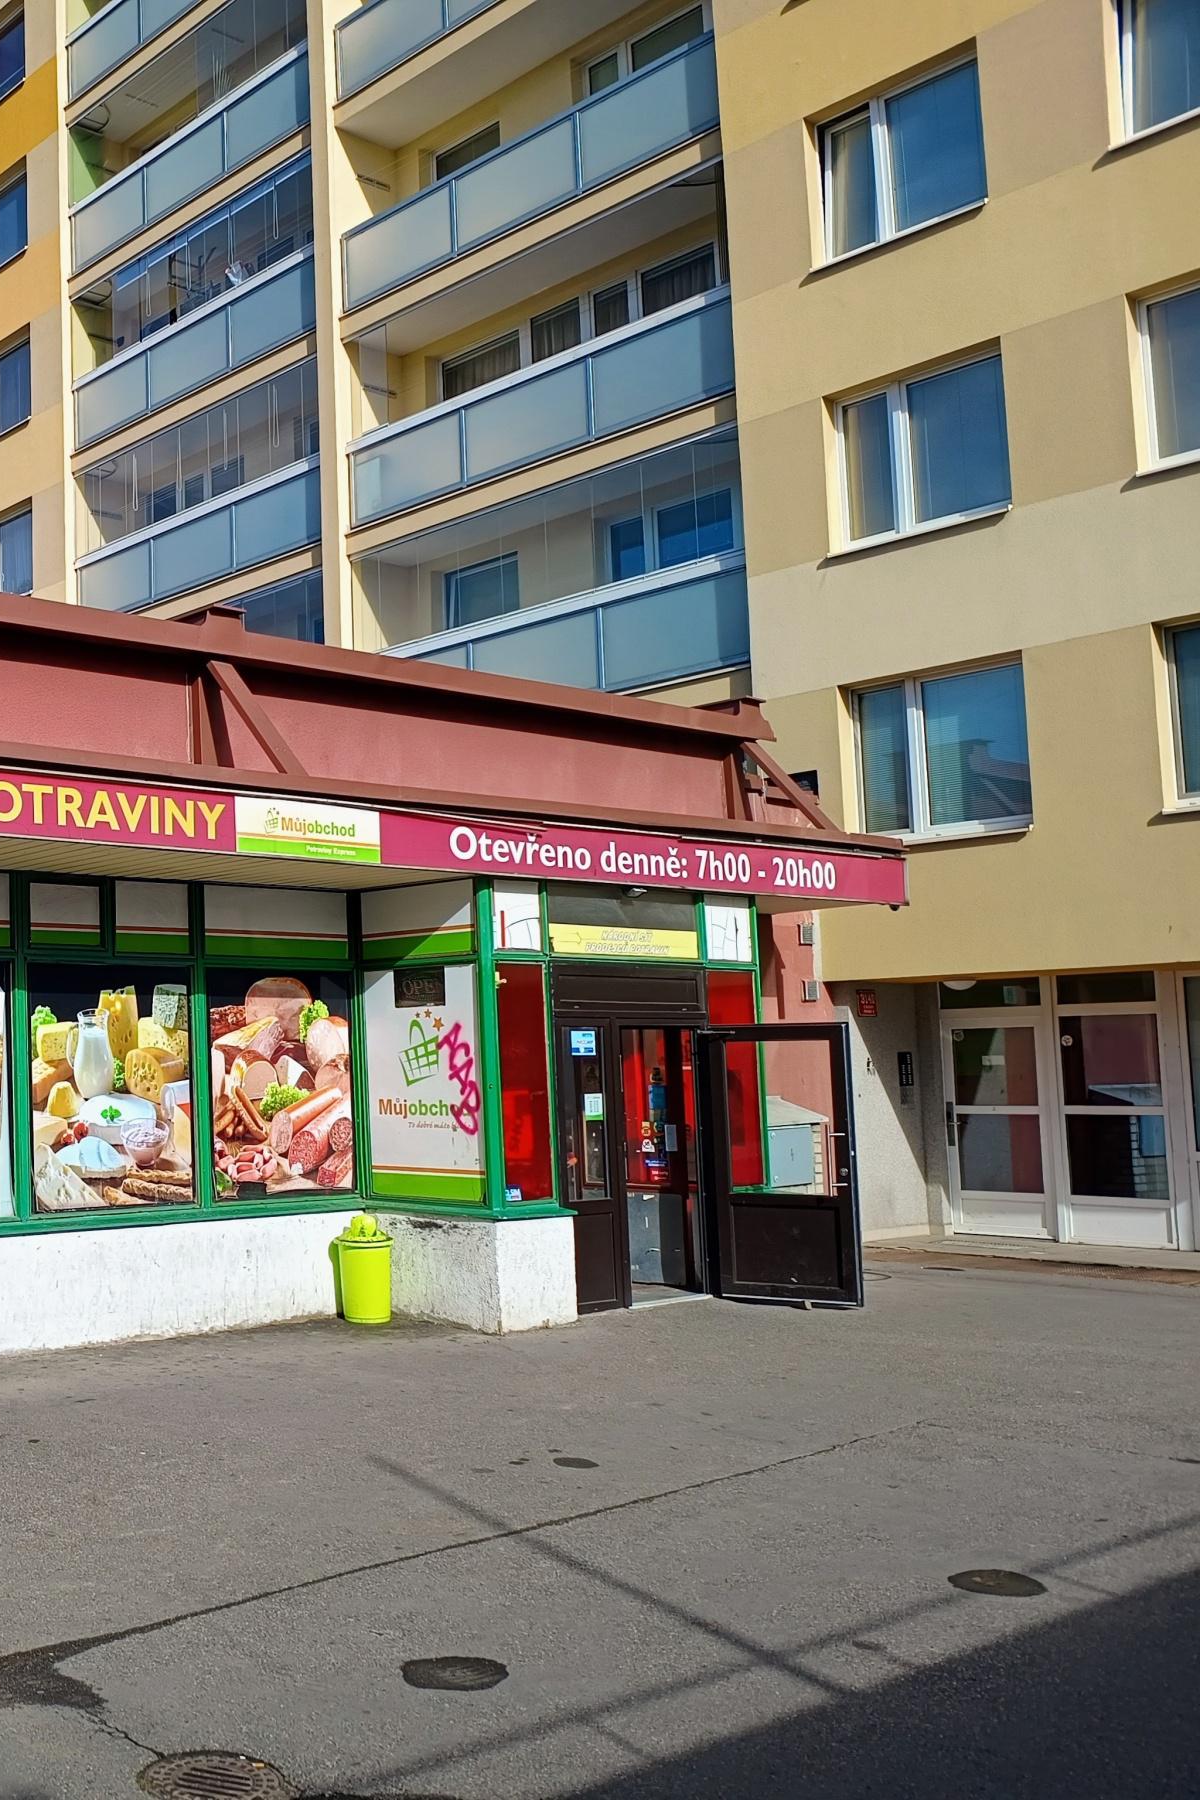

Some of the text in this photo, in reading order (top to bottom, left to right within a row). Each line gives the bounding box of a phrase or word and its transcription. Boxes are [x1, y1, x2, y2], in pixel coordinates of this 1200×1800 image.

[281, 816, 356, 837] Můjobchod
[449, 826, 837, 890] Otevřeno denně: 7h00 - 20h00
[378, 1097, 474, 1119] Můjobch
